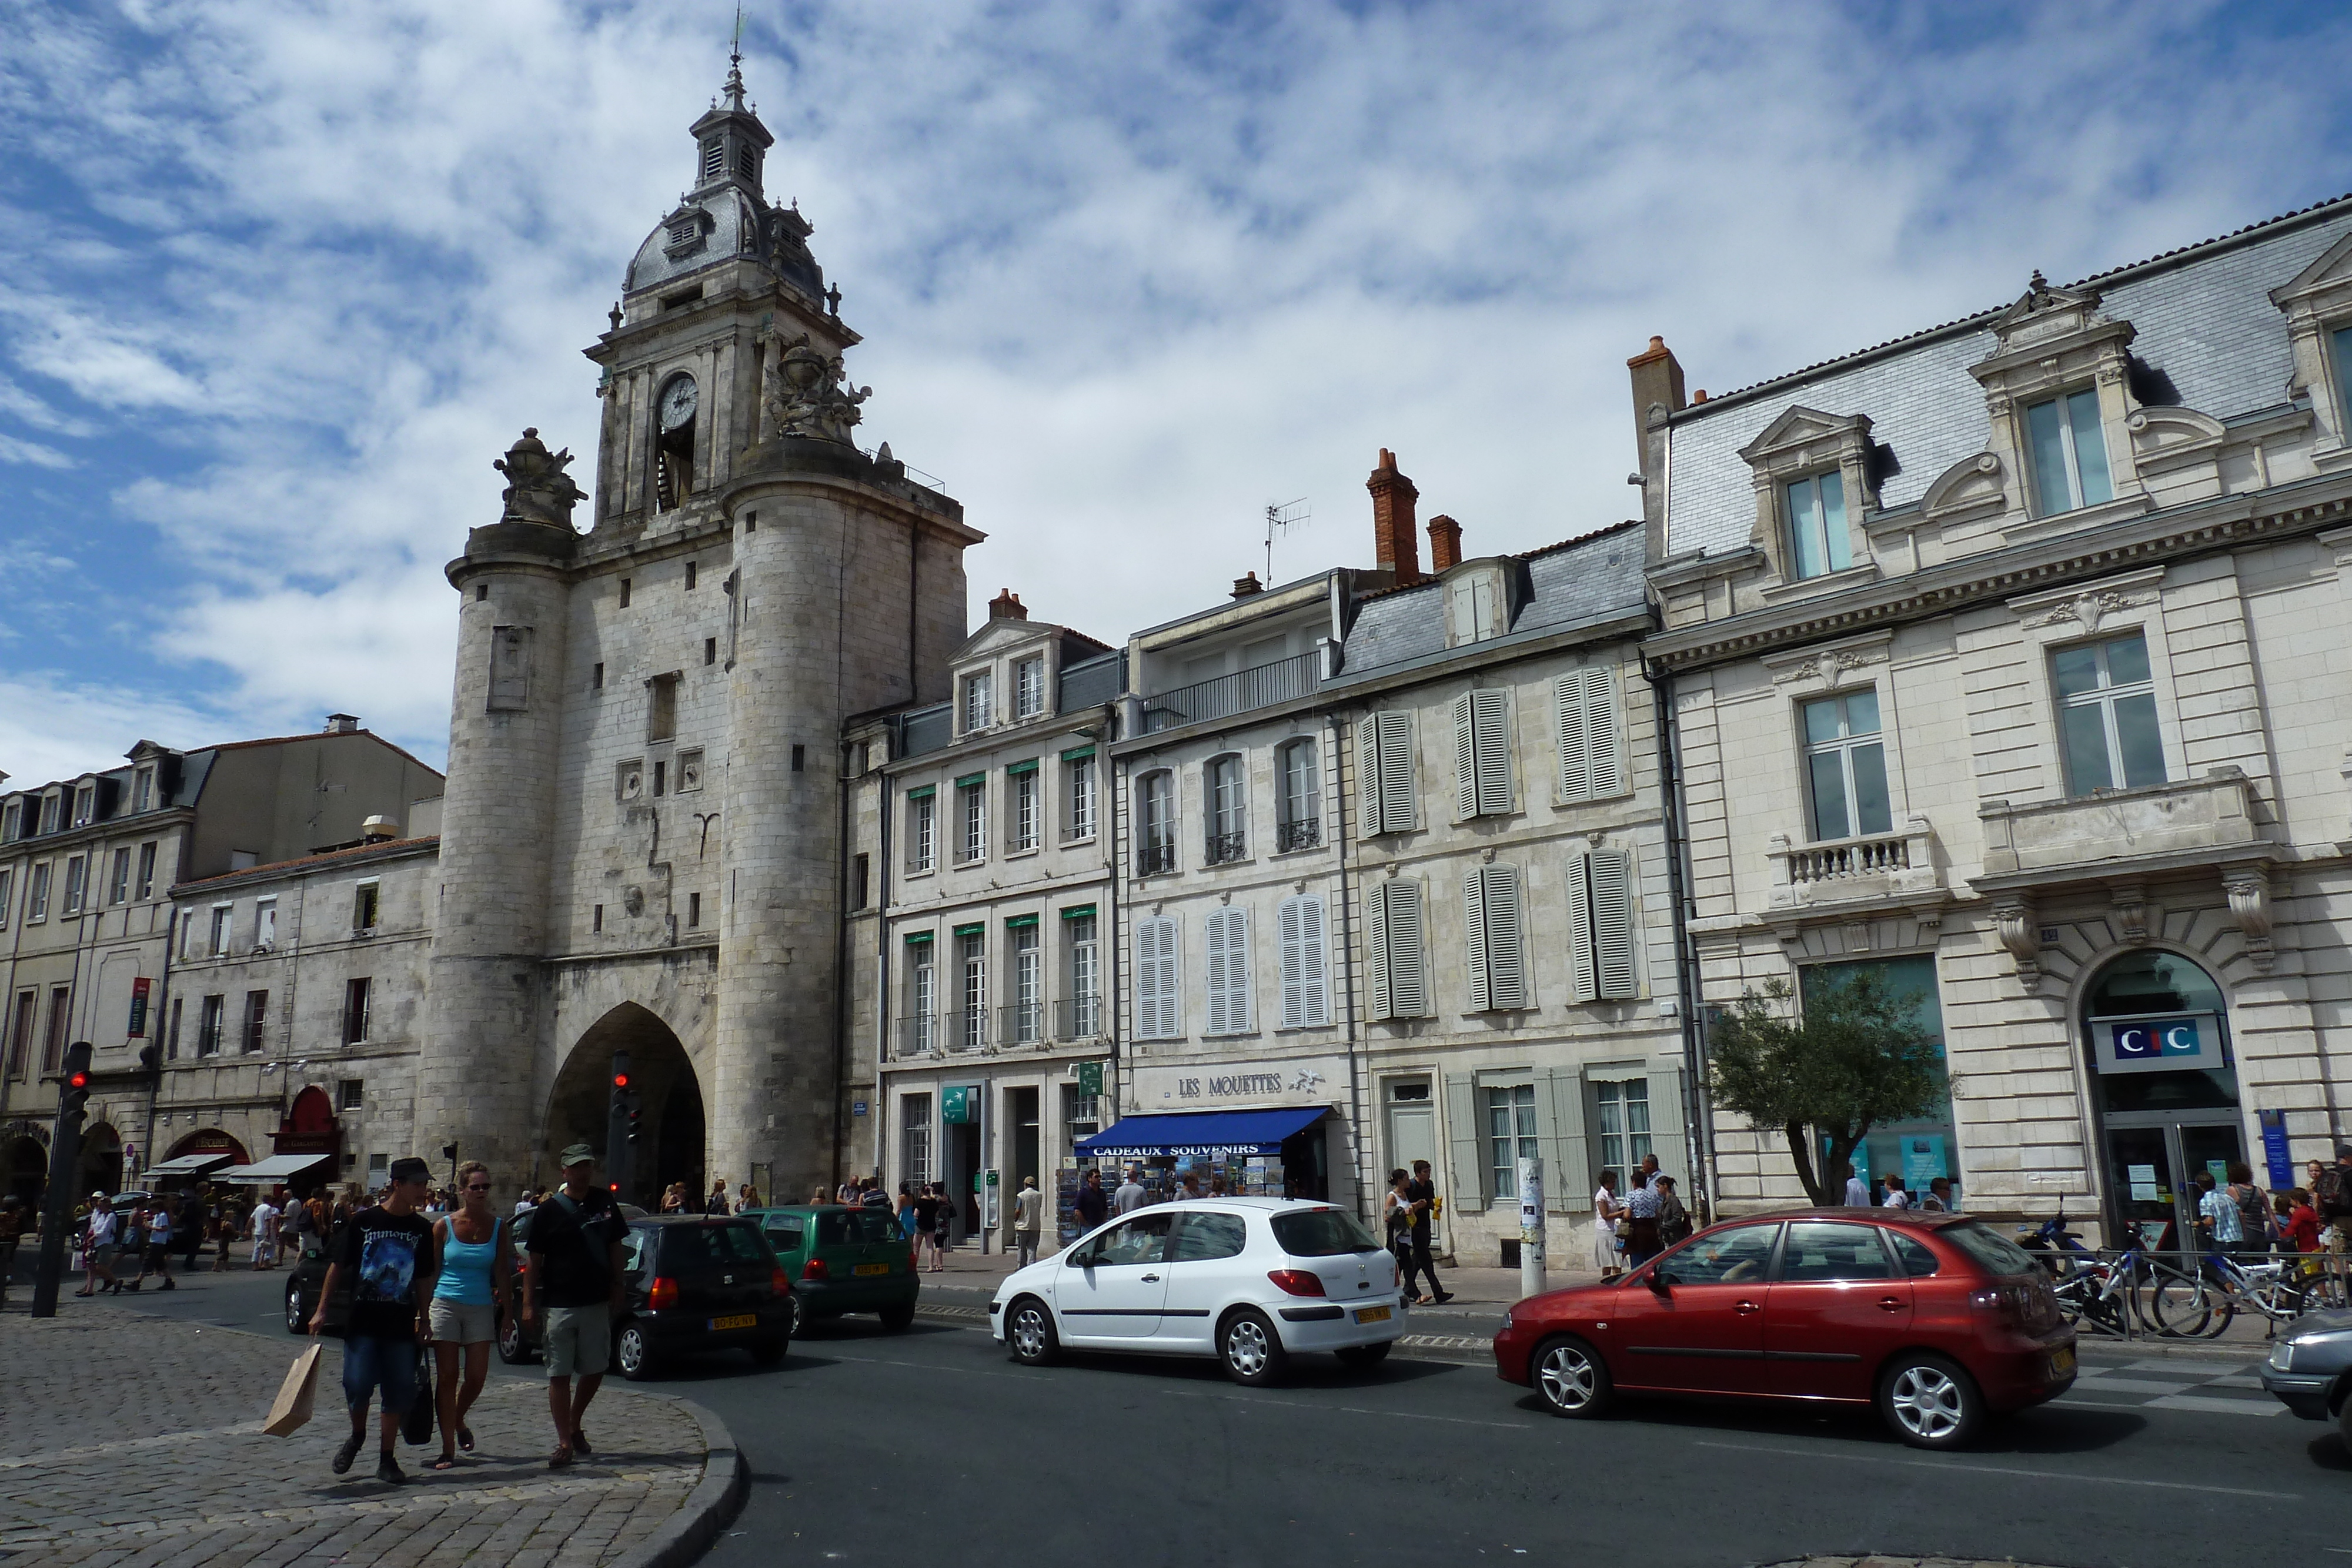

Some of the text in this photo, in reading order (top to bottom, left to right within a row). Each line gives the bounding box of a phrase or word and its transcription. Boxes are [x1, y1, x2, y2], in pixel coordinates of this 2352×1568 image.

[2121, 1027, 2191, 1052] CIC
[1178, 1073, 1282, 1097] LES MOUETTES
[1094, 1144, 1259, 1156] CADEAUX SOUVENIRS
